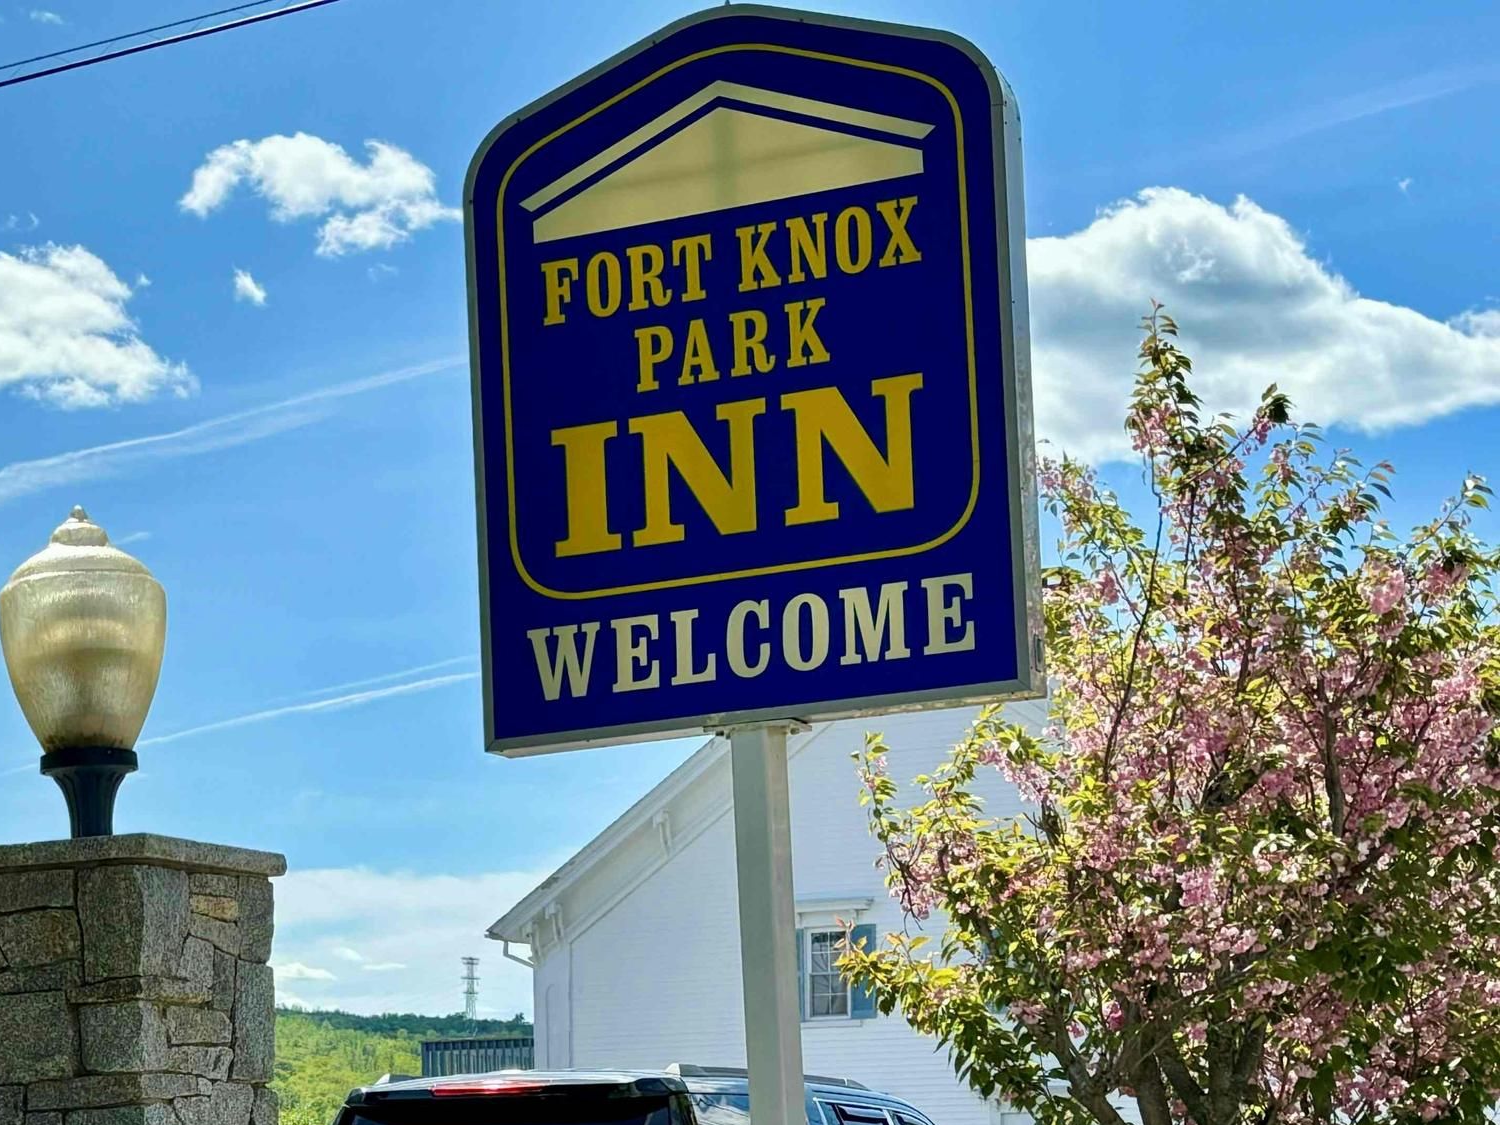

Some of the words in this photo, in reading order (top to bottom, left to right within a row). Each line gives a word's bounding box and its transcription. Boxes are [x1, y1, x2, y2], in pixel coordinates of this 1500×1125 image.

[540, 233, 712, 327] FORT
[736, 195, 922, 294] KNOX
[634, 297, 831, 393] PARK
[550, 373, 924, 558] INN
[526, 572, 976, 702] WELCOME
